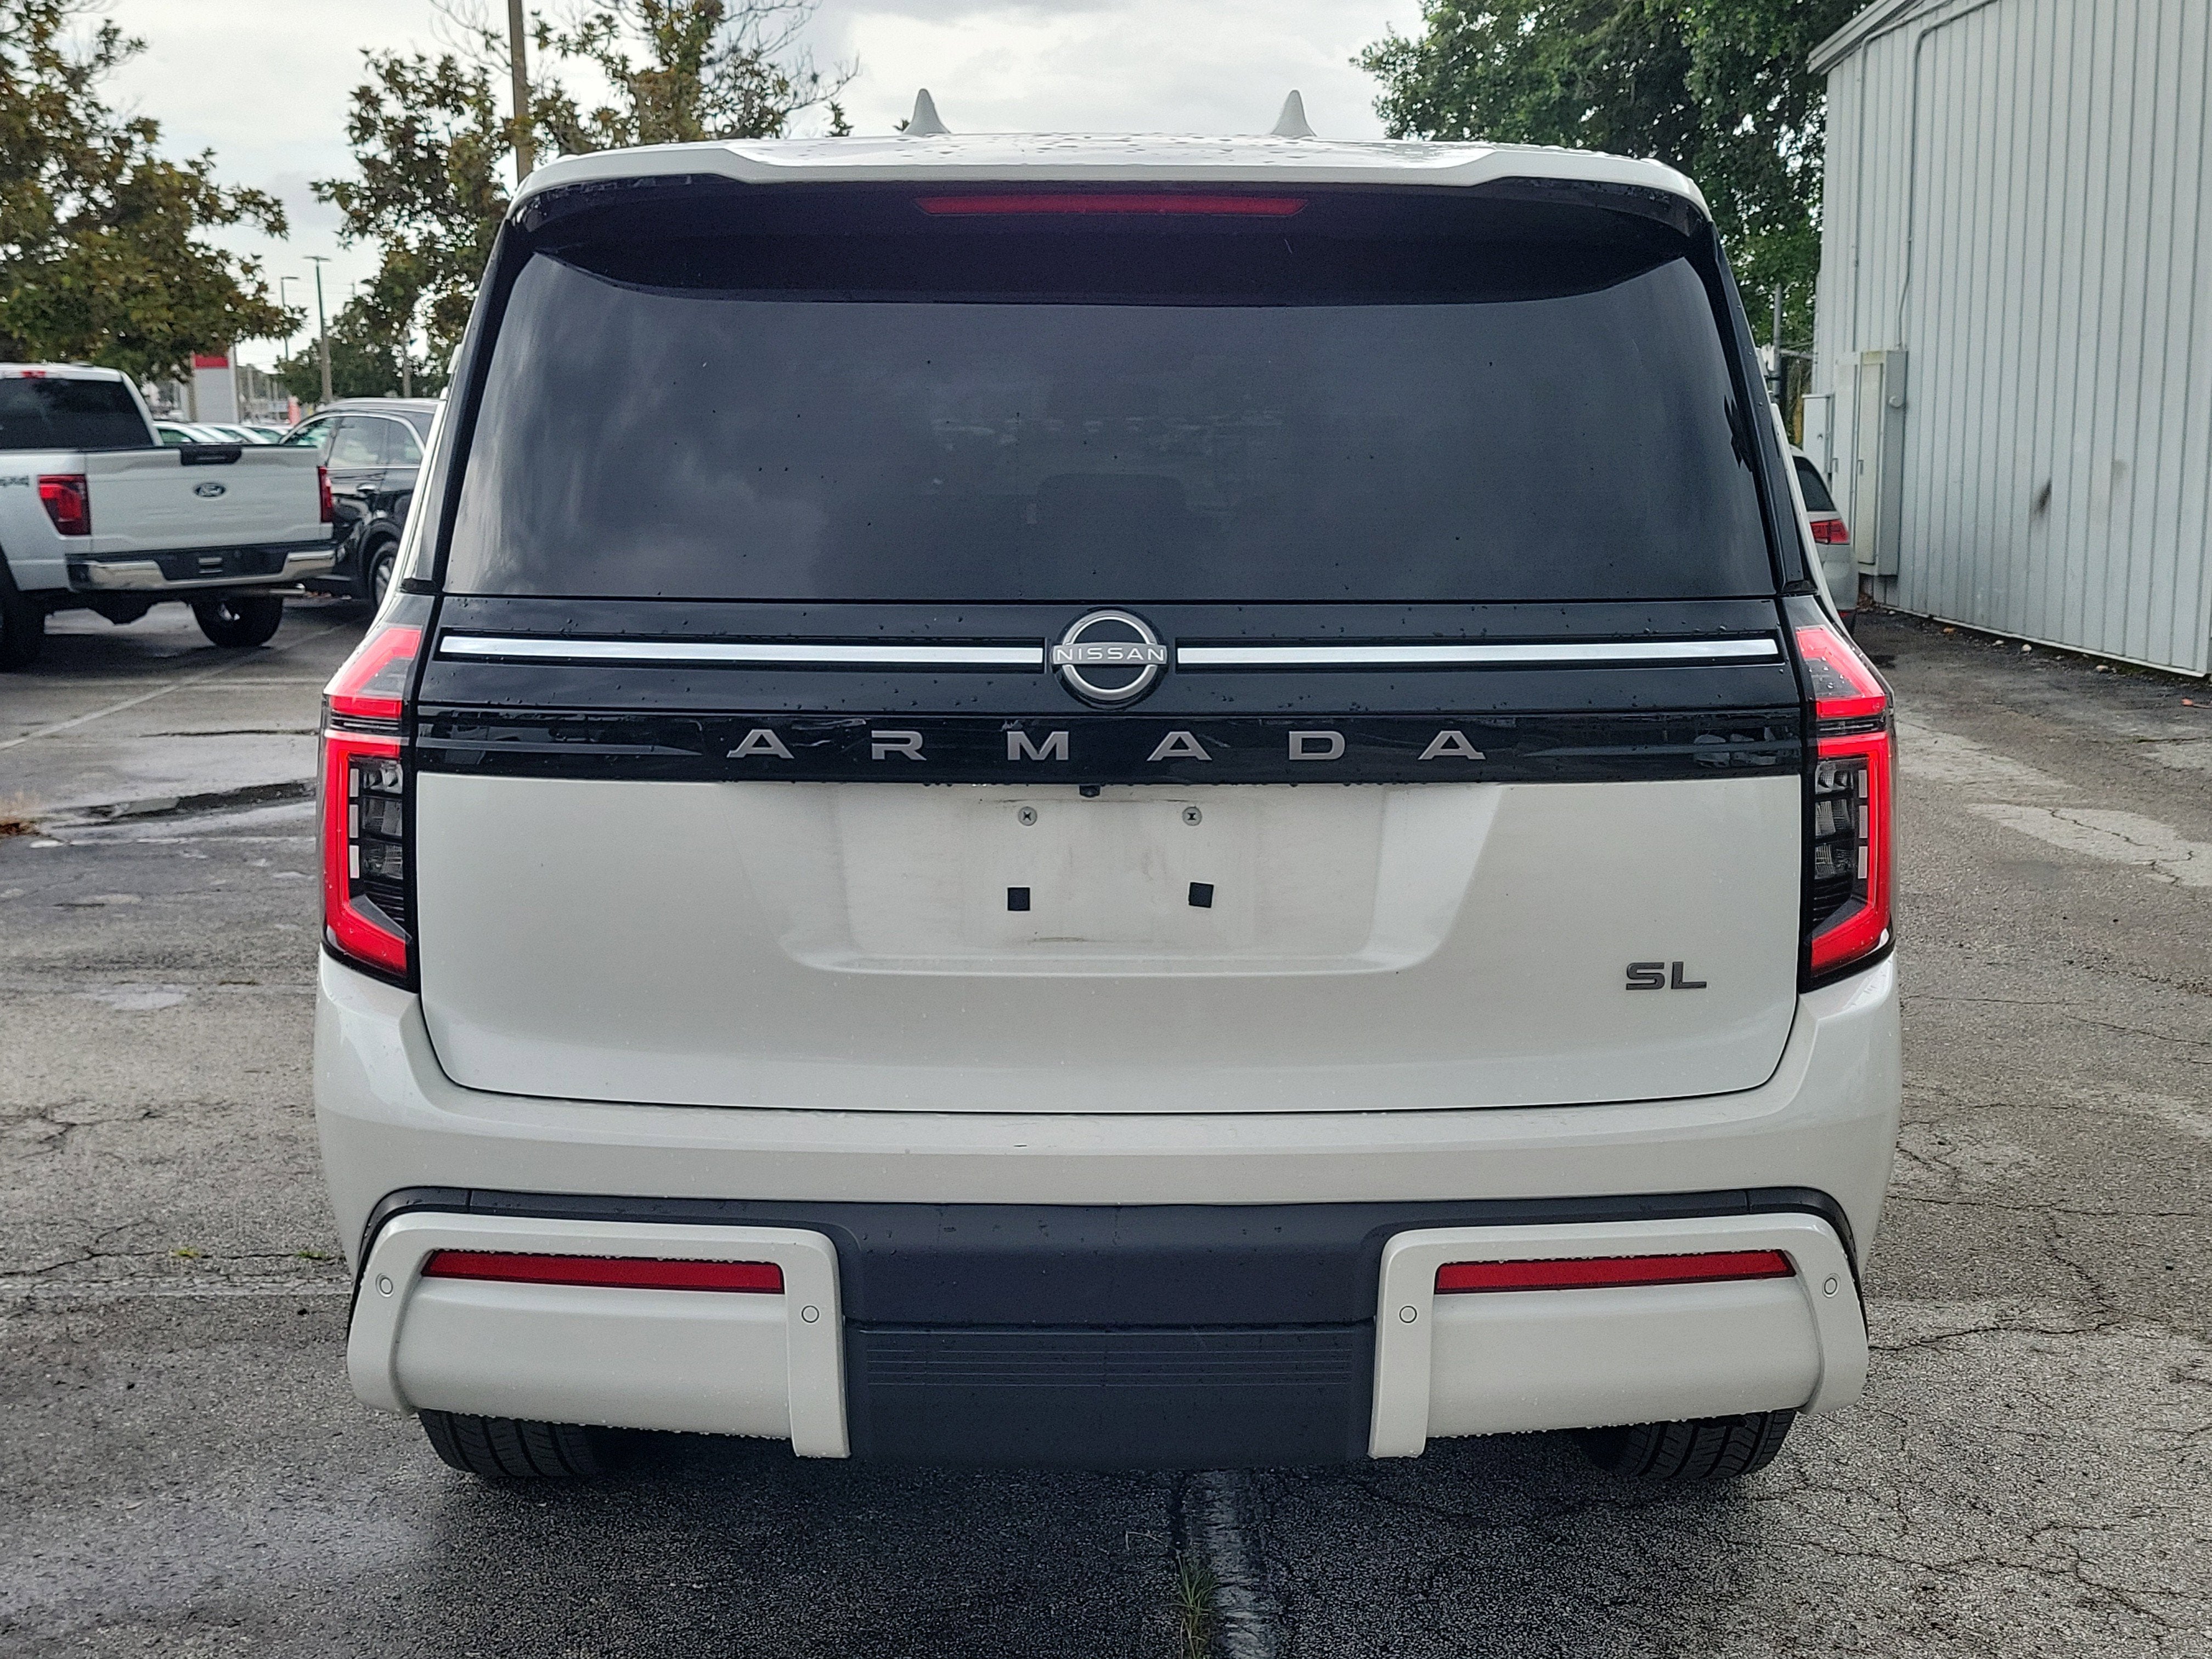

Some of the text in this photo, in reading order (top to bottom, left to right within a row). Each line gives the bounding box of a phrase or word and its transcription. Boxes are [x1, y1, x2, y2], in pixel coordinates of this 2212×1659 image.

[1057, 647, 1164, 661] NISSAN
[726, 728, 1486, 761] ARMADA
[1626, 962, 1707, 990] SL
